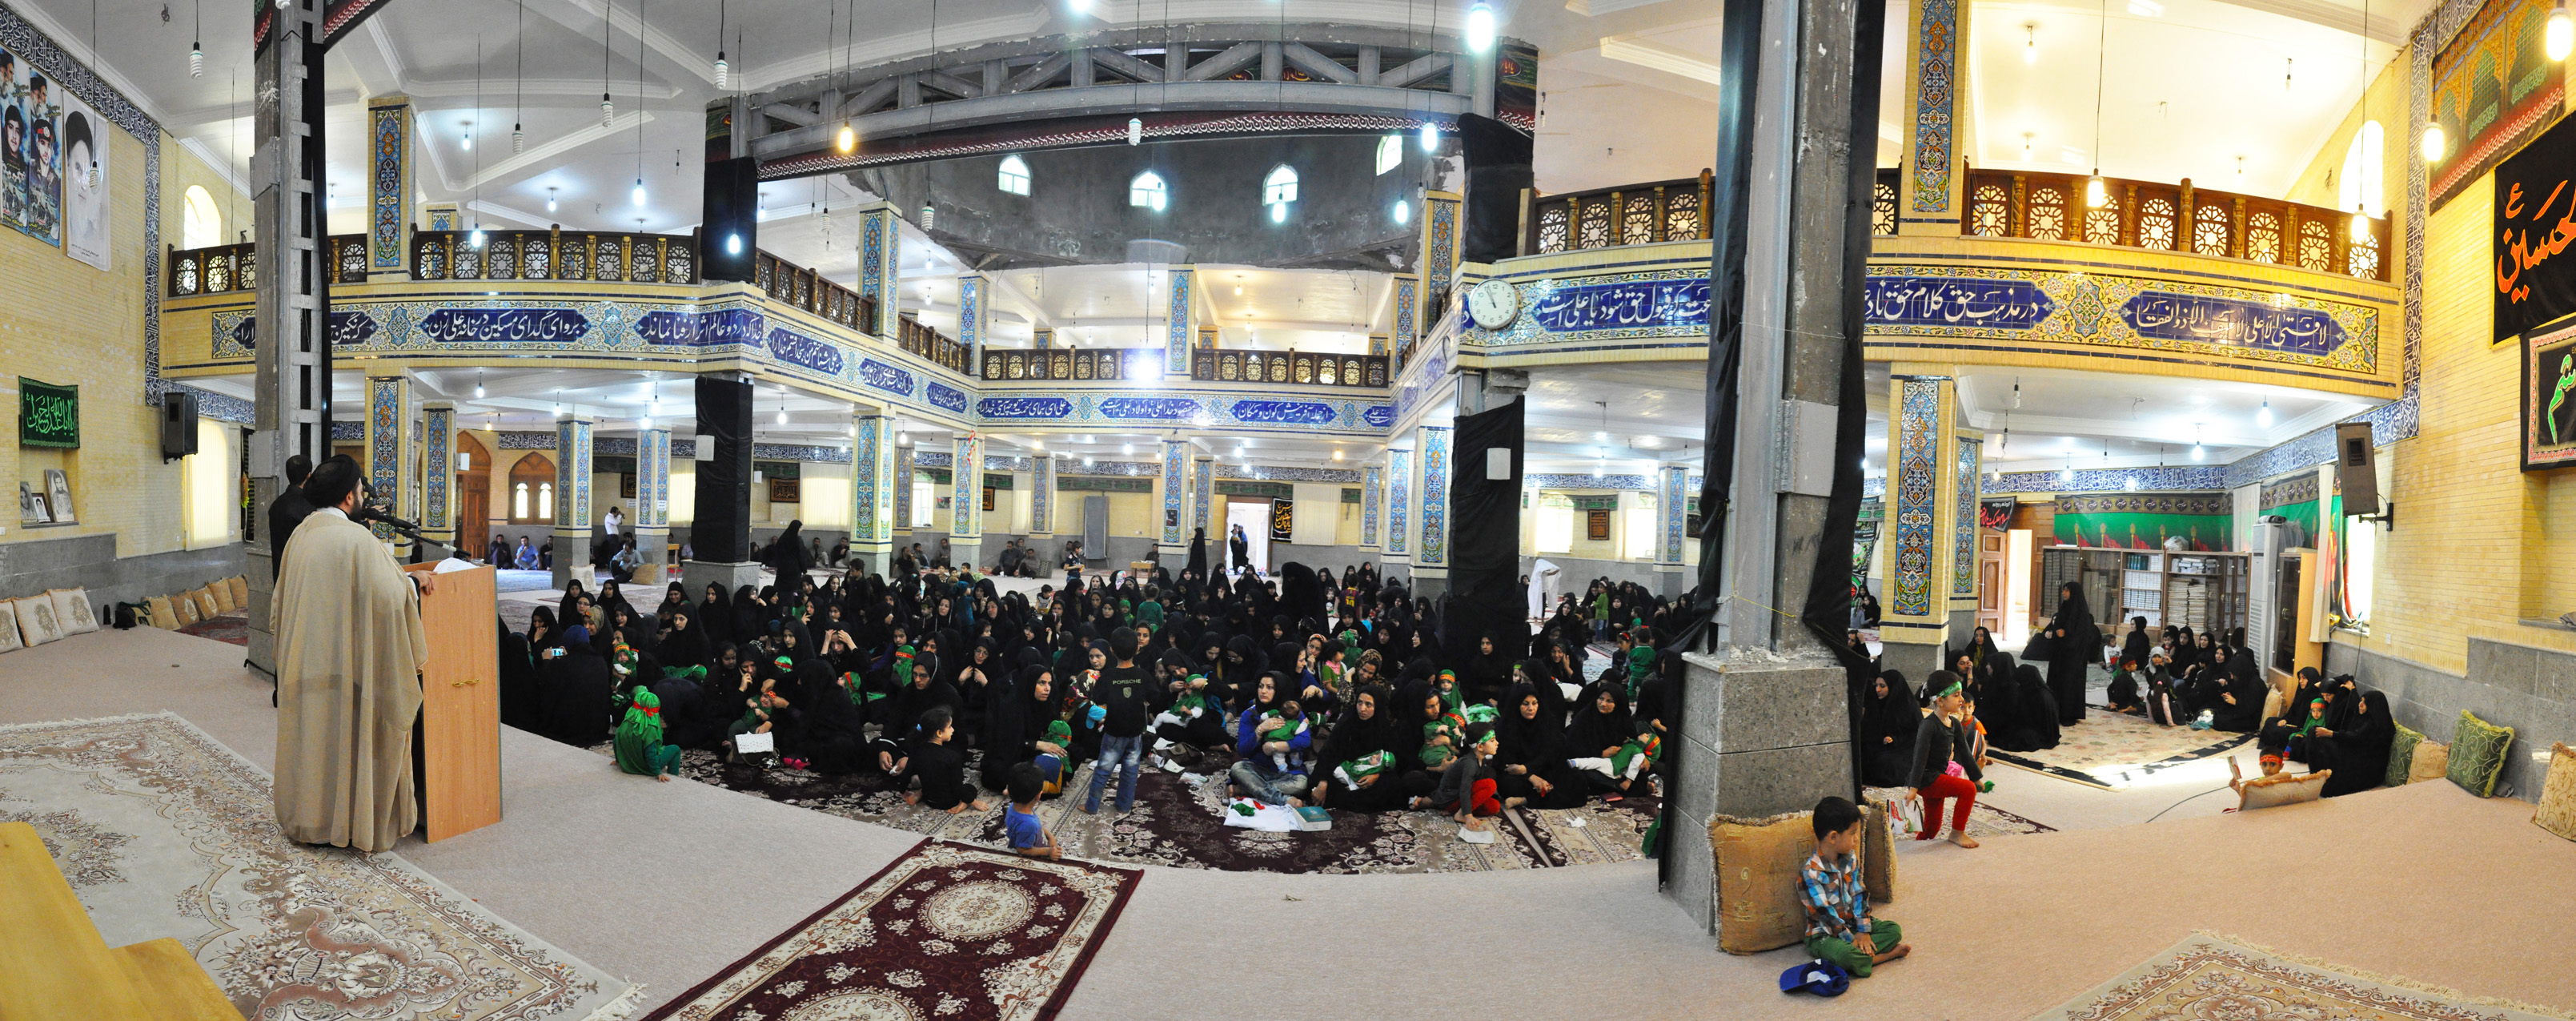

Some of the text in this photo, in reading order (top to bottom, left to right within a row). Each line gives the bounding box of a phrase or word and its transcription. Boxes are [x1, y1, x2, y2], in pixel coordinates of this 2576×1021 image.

[1599, 288, 1624, 320] شود
[1619, 288, 1646, 324] حق
[1635, 284, 1673, 324] قبول
[1670, 281, 1695, 315] که
[1884, 288, 1915, 320] حق
[1911, 279, 1950, 322] کلام
[1944, 289, 1976, 322] حق
[1966, 287, 2021, 326] مذهب
[477, 313, 489, 326] در
[1542, 295, 1575, 327] است
[1564, 294, 1589, 328] علی
[2019, 302, 2039, 320] در
[331, 312, 369, 344] که نگین
[428, 311, 449, 337] زن
[444, 312, 465, 341] علی
[479, 309, 518, 341] مسکین
[511, 310, 557, 340] گدای
[542, 316, 564, 340] ای
[563, 320, 580, 336] برو
[644, 316, 671, 340] نماند
[673, 316, 688, 340] فنا
[684, 319, 696, 340] از
[695, 315, 708, 341] اثر
[708, 313, 726, 345] عالم
[725, 324, 737, 337] دو
[736, 325, 746, 337] در
[2236, 319, 2245, 339] لا
[2244, 316, 2265, 343] علی
[2272, 316, 2320, 347] فتی
[778, 336, 787, 355] خدا
[2318, 324, 2328, 346] لا
[785, 335, 798, 362] قسم
[804, 345, 814, 364] من
[811, 341, 831, 369] شناختم
[828, 352, 838, 372] علی
[979, 402, 985, 413] را
[985, 402, 994, 413] خدا
[1009, 402, 1032, 415] رحمت
[1029, 401, 1045, 416] همای
[1045, 402, 1056, 416] ای
[1055, 400, 1067, 416] علی
[1119, 402, 1131, 417] علی
[1131, 404, 1148, 416] اولاد
[1151, 401, 1163, 417] علی
[1163, 403, 1174, 415] خدا
[1173, 401, 1195, 416] مقصود
[1238, 403, 1258, 418] مکان
[1263, 402, 1284, 420] کون
[1277, 402, 1314, 421] آفرینش
[1321, 407, 1329, 420] از
